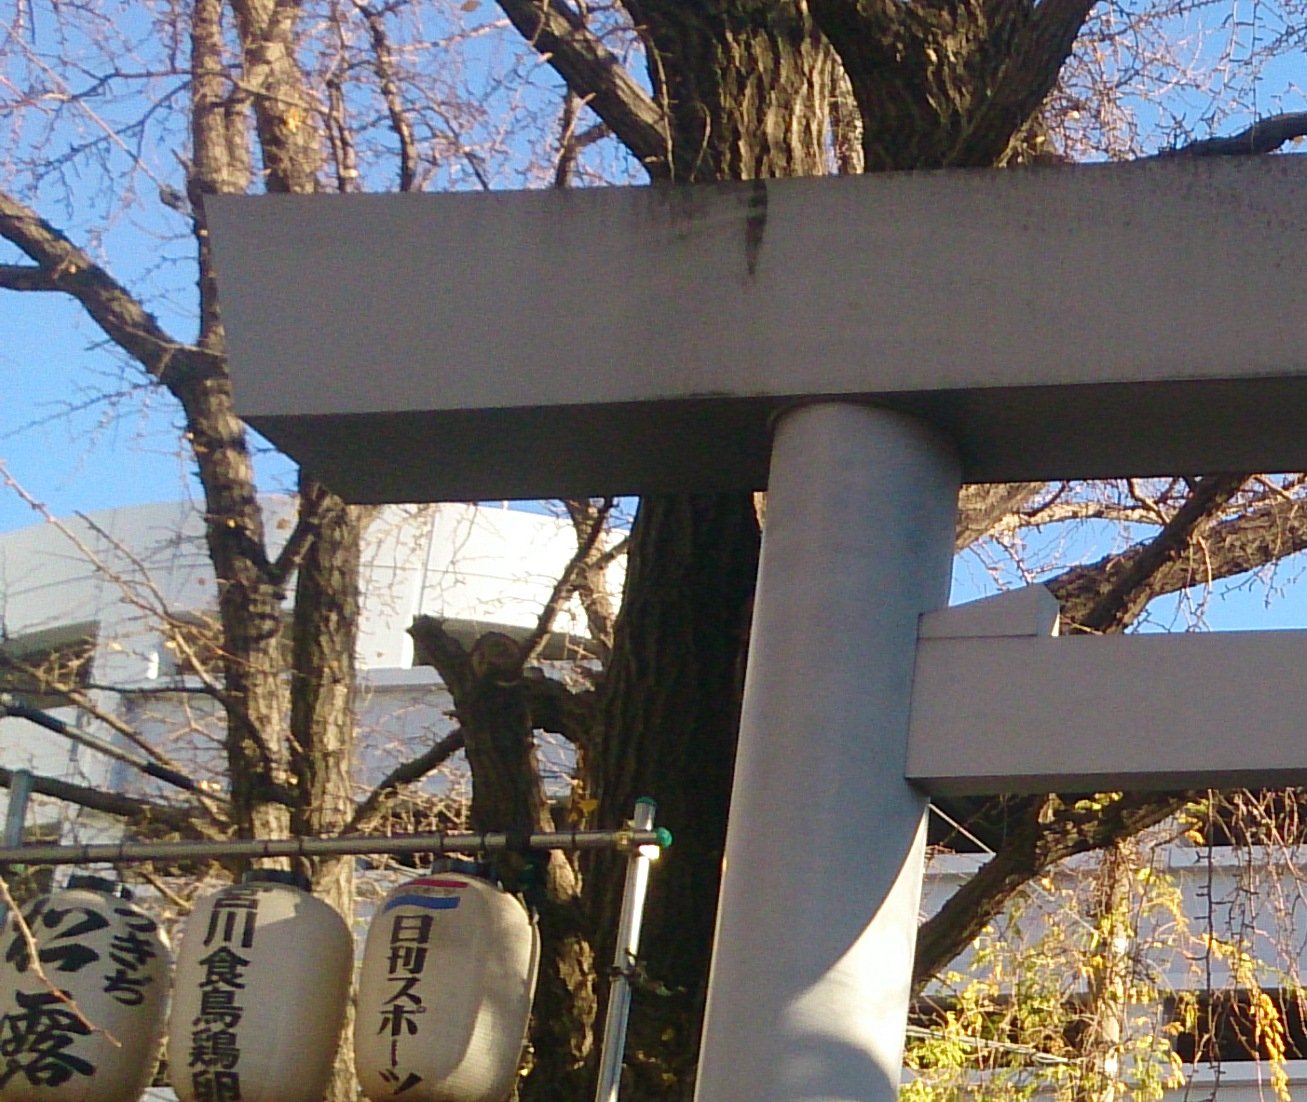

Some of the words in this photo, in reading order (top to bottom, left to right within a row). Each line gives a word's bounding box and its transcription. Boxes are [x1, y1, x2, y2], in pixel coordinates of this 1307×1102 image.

[376, 914, 434, 1095] 日刊スポーツ
